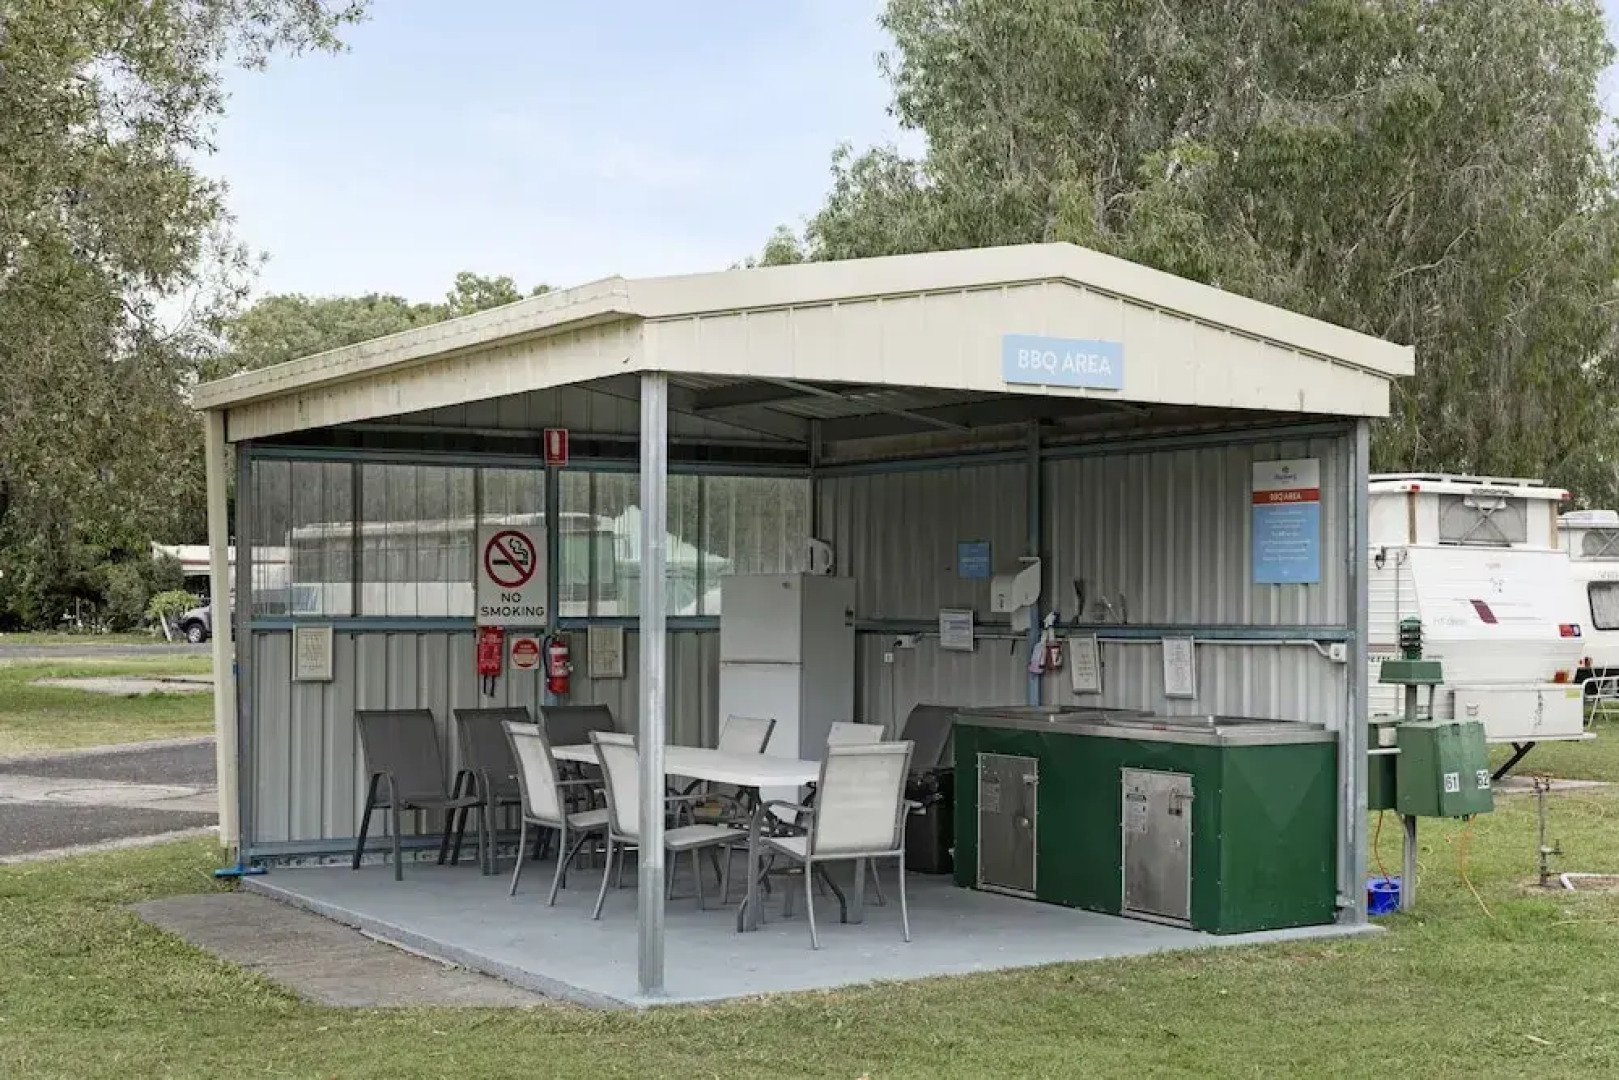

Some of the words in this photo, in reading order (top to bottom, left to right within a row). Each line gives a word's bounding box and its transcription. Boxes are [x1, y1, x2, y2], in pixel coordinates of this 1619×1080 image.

[1018, 348, 1057, 375] BBQ
[1062, 351, 1112, 376] AREA
[502, 592, 521, 603] NO
[480, 606, 545, 617] SMOKING
